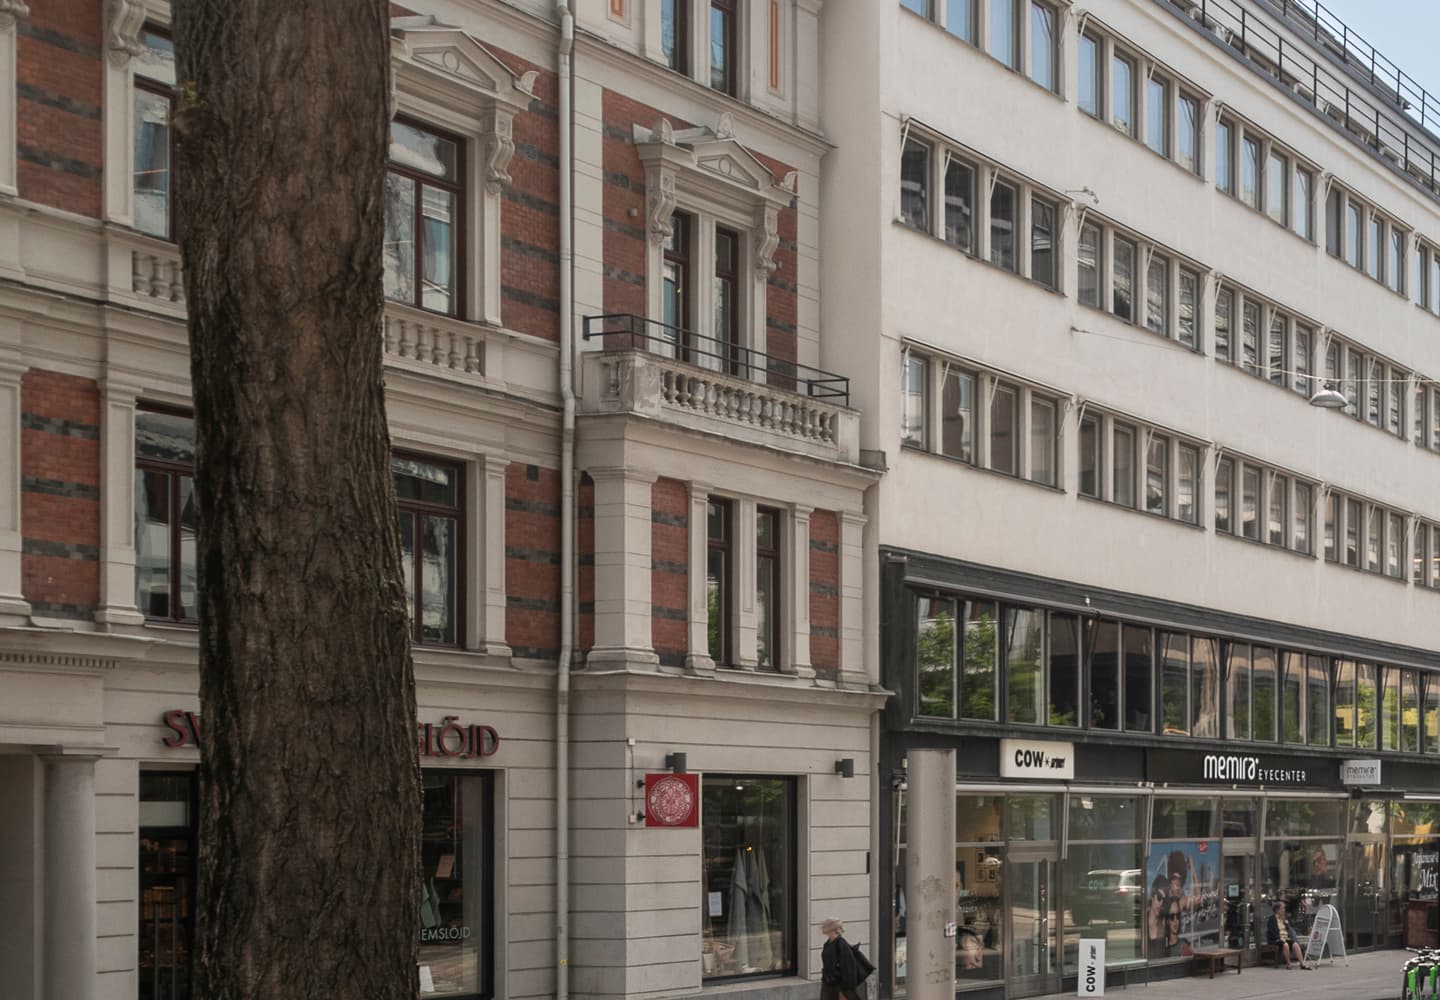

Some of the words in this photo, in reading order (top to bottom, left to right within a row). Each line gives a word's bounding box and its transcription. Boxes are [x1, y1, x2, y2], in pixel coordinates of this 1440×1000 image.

[1014, 748, 1045, 769] COW
[1203, 755, 1259, 780] memira
[1258, 768, 1306, 782] EYECENTER
[1086, 965, 1096, 993] COW
